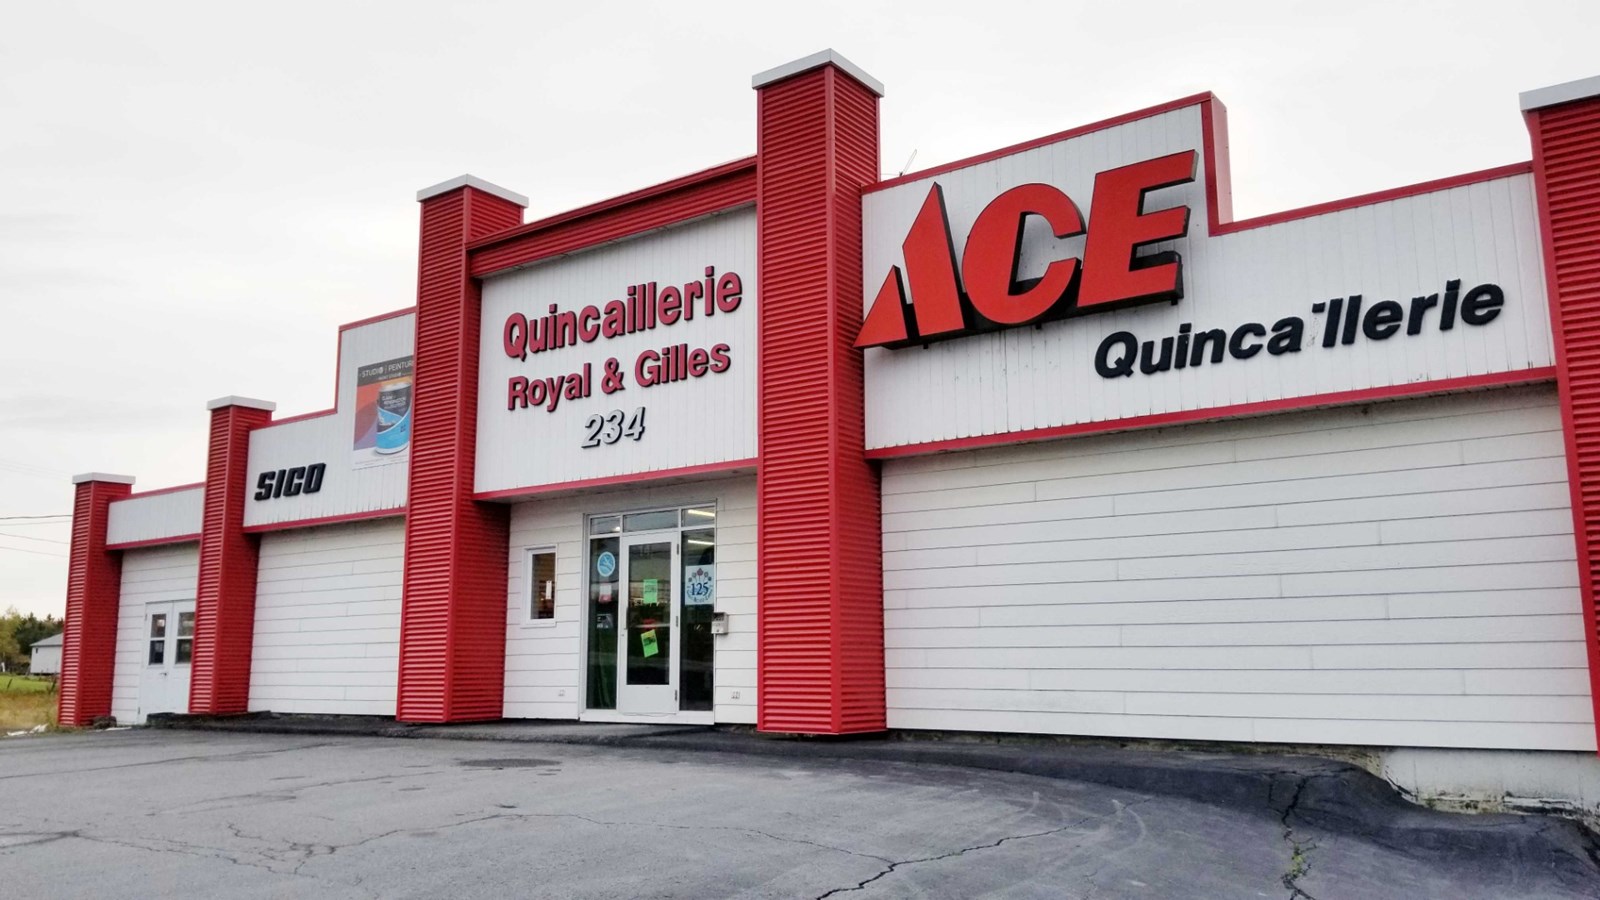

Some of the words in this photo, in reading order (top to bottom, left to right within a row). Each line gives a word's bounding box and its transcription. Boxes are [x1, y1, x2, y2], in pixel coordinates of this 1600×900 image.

[853, 148, 1198, 351] ACE
[503, 265, 742, 361] Quincaillerie
[1094, 278, 1504, 379] Quincallerie
[507, 362, 591, 413] Royal
[601, 357, 625, 395] &
[634, 343, 732, 388] Gilles
[581, 406, 646, 449] 234
[254, 462, 326, 501] SICO
[691, 582, 709, 597] 125
